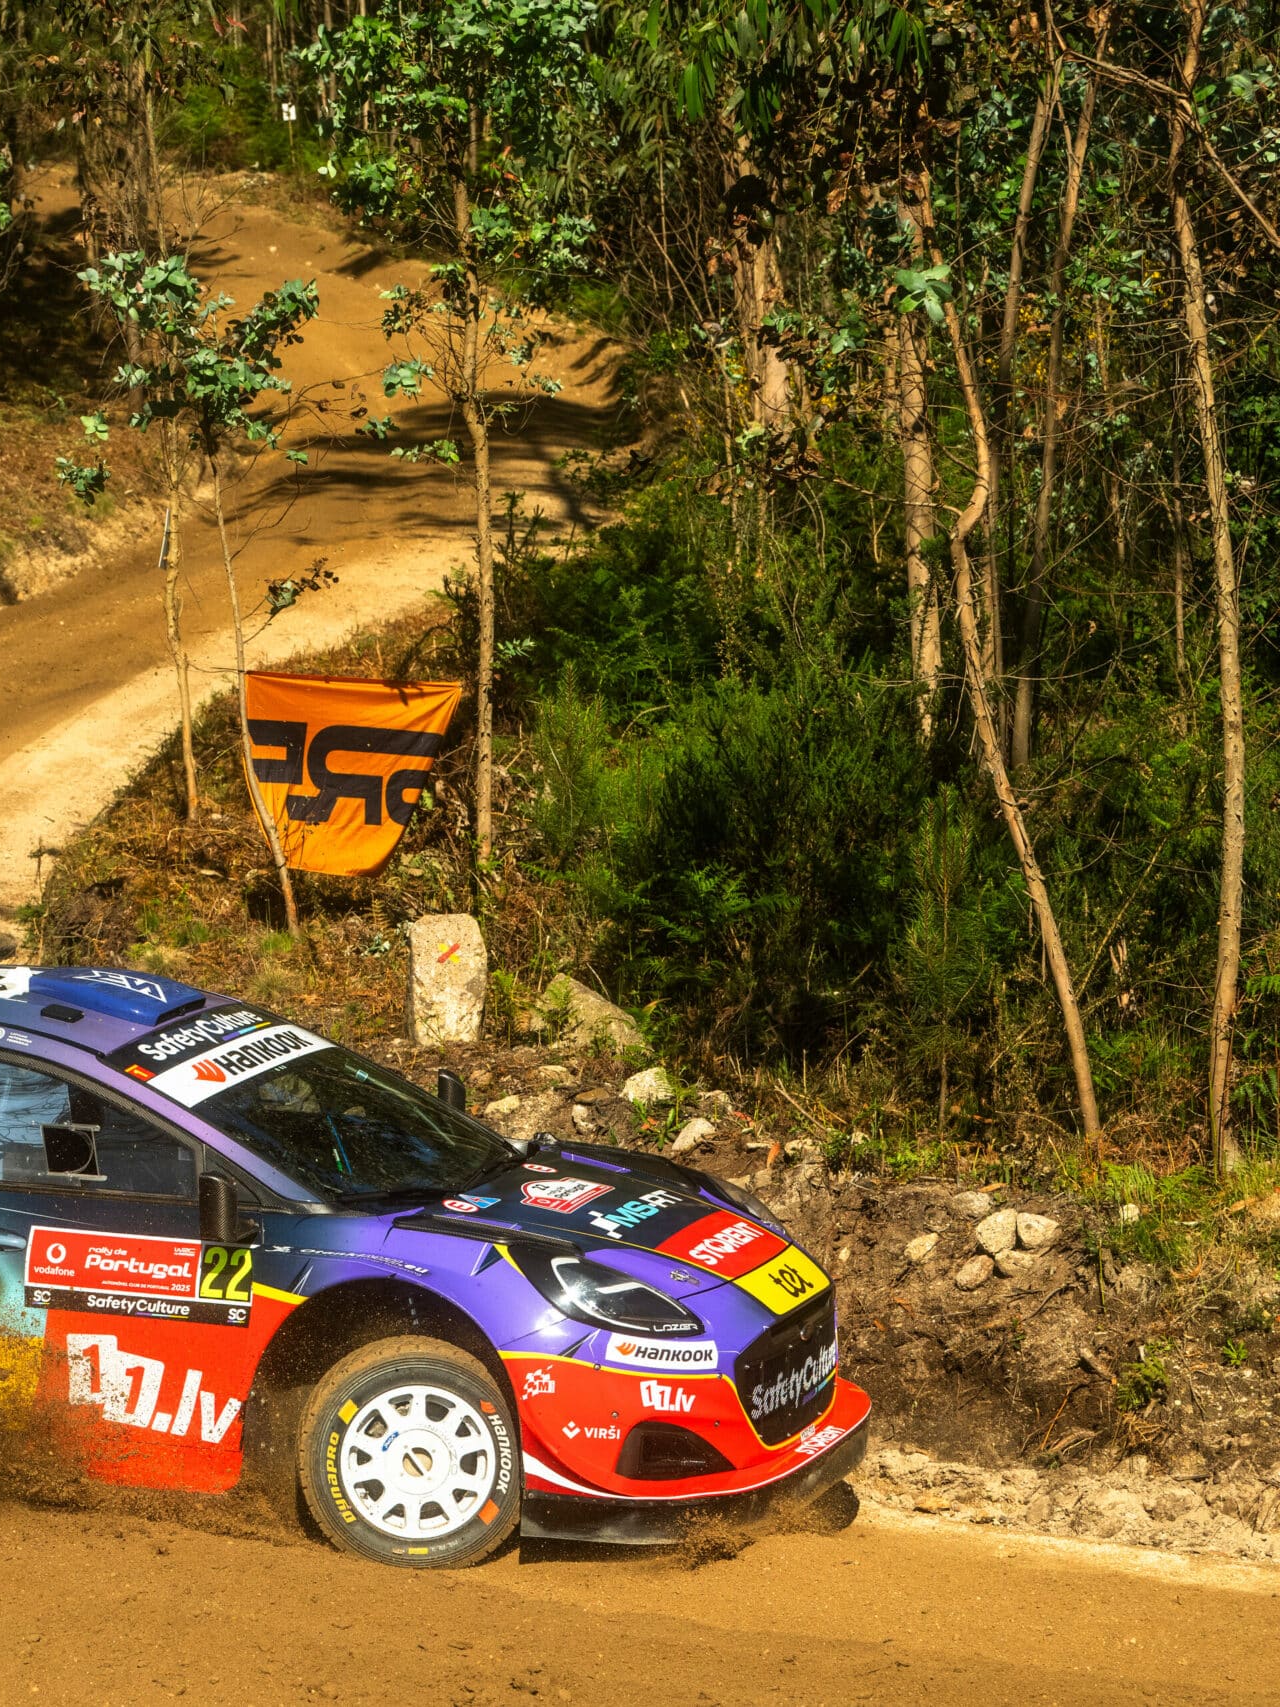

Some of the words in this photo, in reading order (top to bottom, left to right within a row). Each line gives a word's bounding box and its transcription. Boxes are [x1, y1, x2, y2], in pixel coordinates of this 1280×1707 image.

[138, 1009, 263, 1061] SafetyCulture
[88, 1247, 113, 1256] rally
[114, 1248, 128, 1256] de
[688, 1221, 765, 1265] STORENT
[34, 1265, 75, 1277] vodafone
[84, 1254, 193, 1279] Portugal
[200, 1246, 254, 1301] 22
[33, 1290, 51, 1302] SC
[171, 1283, 191, 1292] 2025
[86, 1294, 190, 1315] SafetyCulture
[228, 1308, 246, 1321] SC
[640, 1380, 696, 1413] 11.lv
[584, 1425, 620, 1440] VIRŠI
